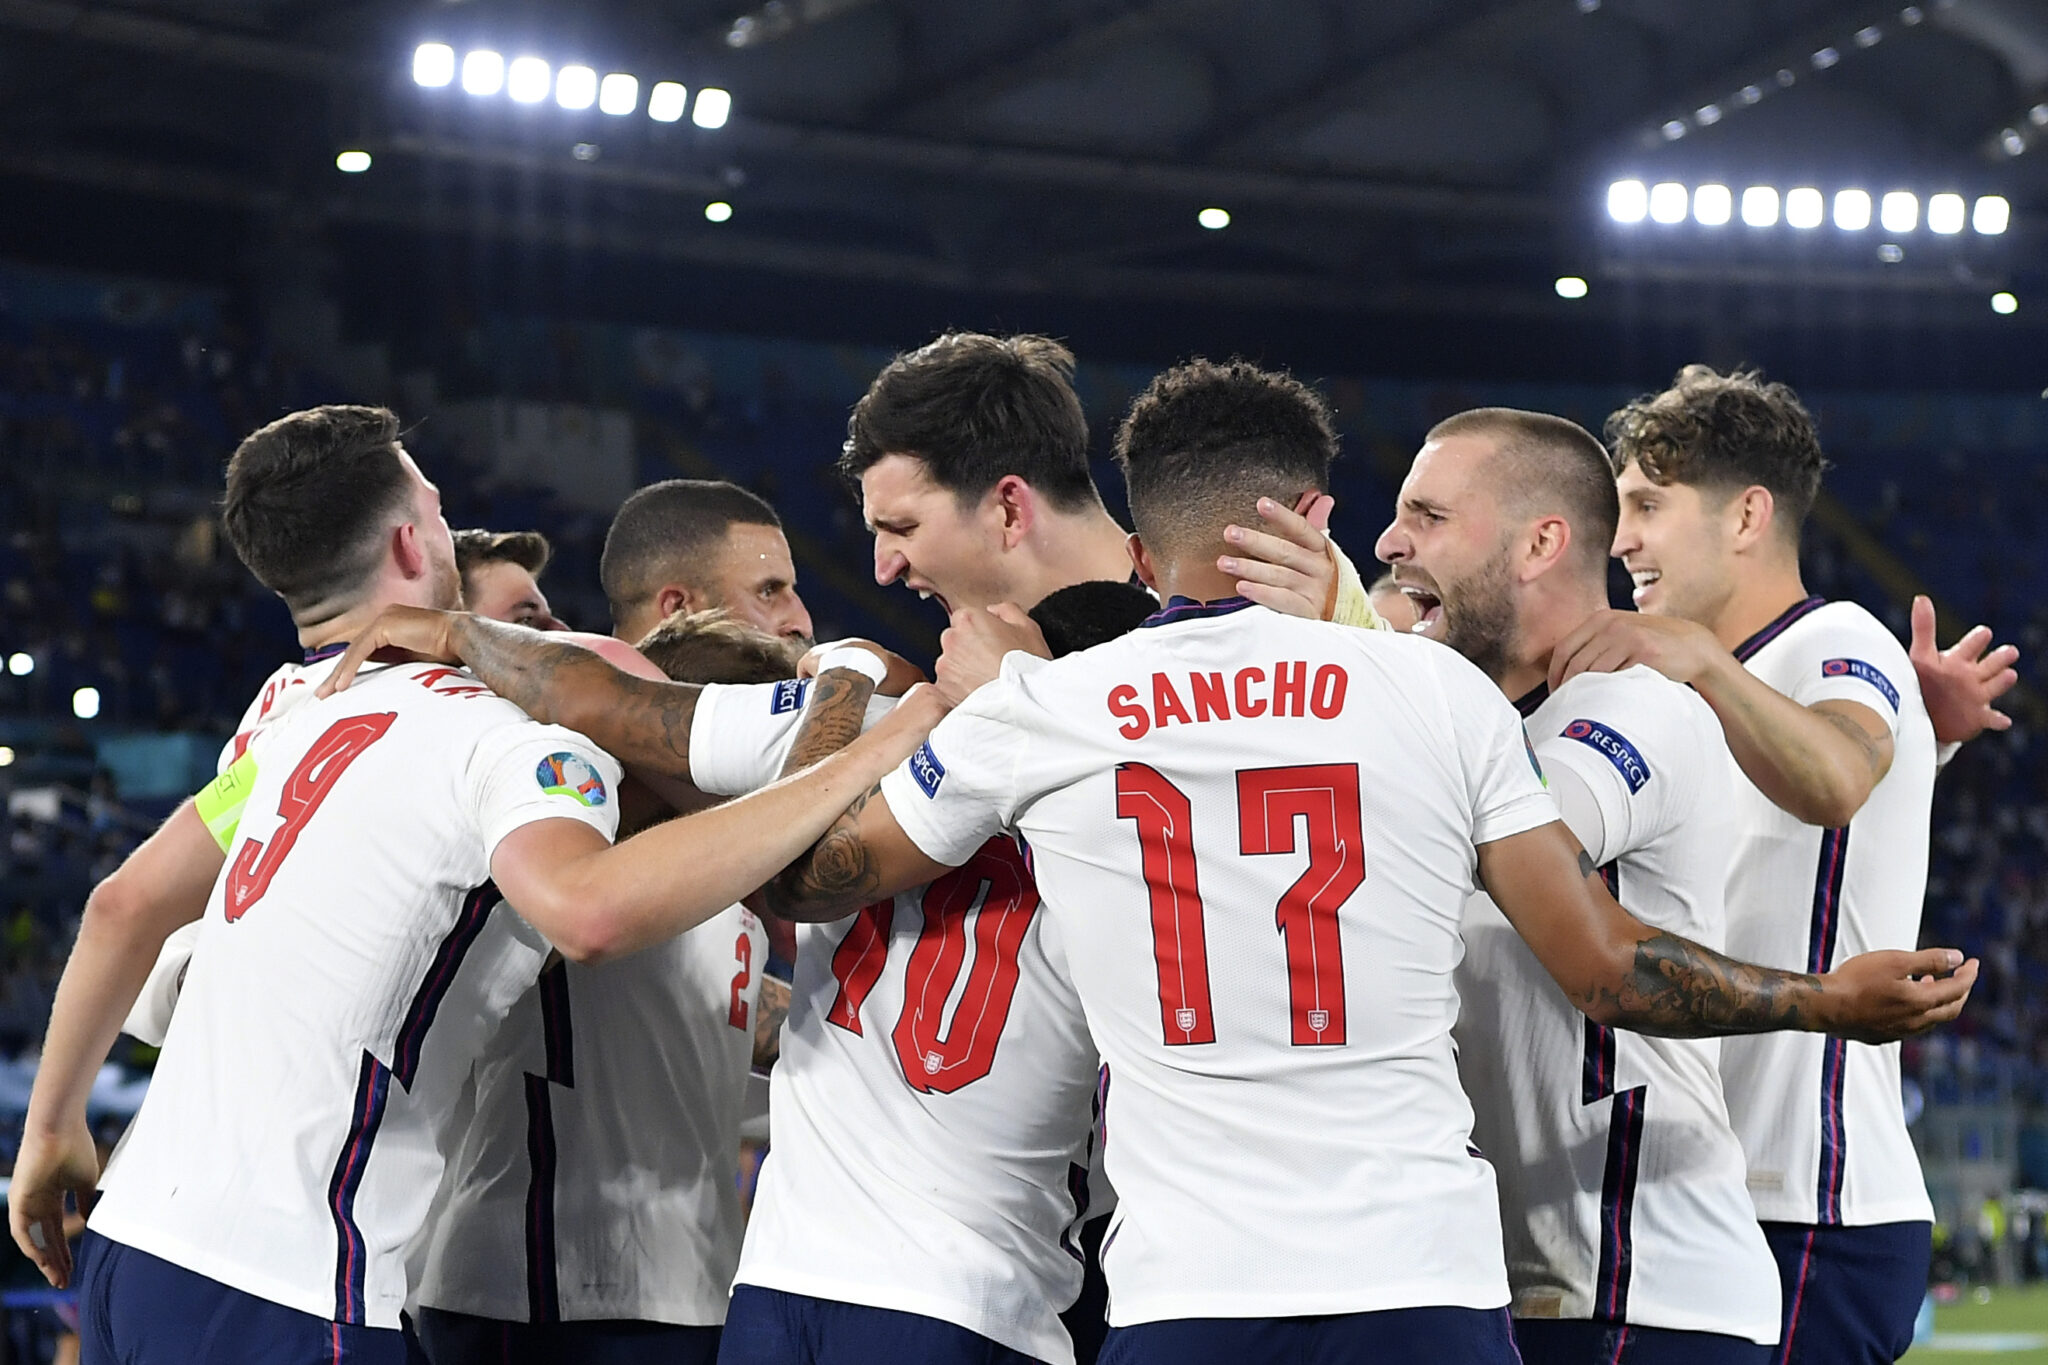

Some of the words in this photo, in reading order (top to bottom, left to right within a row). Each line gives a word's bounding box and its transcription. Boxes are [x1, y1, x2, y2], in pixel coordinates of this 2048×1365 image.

[1107, 660, 1349, 740] SANCHO
[1589, 730, 1646, 787] RESPECT
[224, 711, 398, 923] 9
[1115, 762, 1366, 1046] 17
[728, 932, 751, 1031] 2
